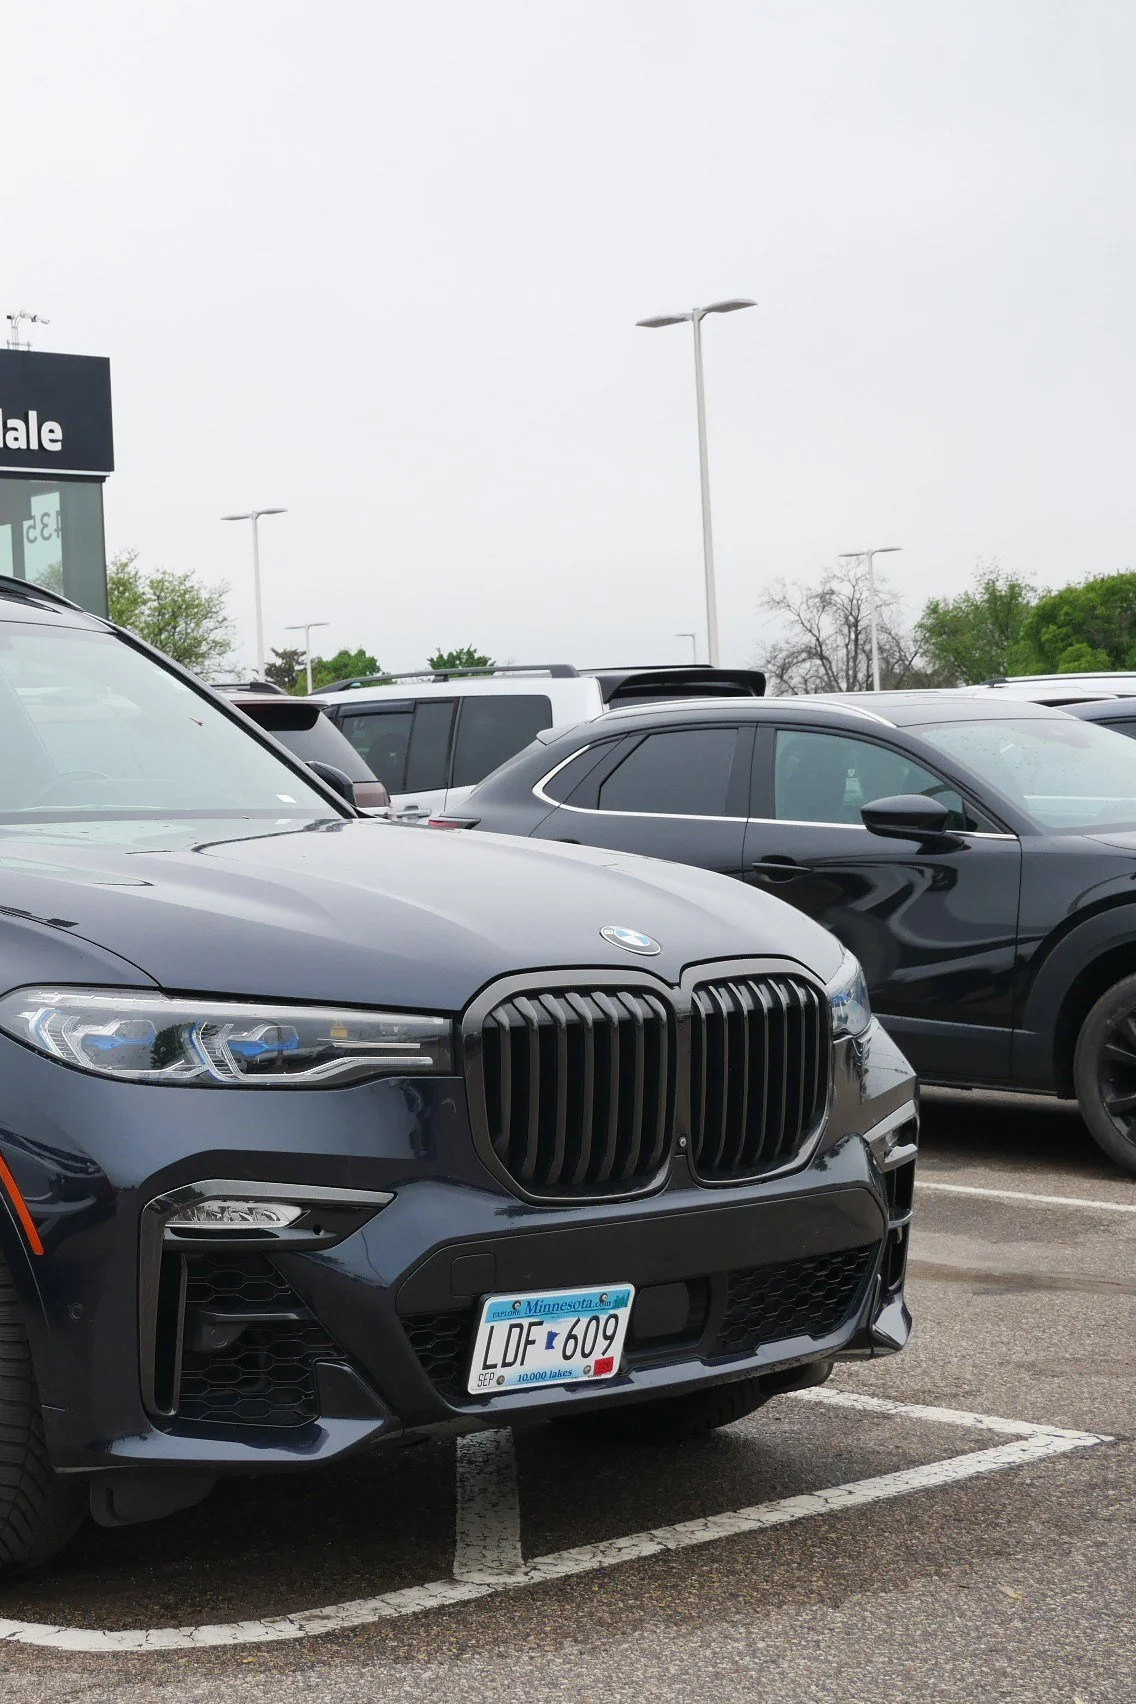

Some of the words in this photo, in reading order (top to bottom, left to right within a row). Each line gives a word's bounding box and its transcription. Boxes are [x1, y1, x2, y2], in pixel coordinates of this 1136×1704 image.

[481, 1320, 544, 1371] LDF
[561, 1313, 620, 1361] 609
[477, 1371, 495, 1388] SEP
[517, 1370, 547, 1383] 10,000
[549, 1368, 573, 1379] lakes
